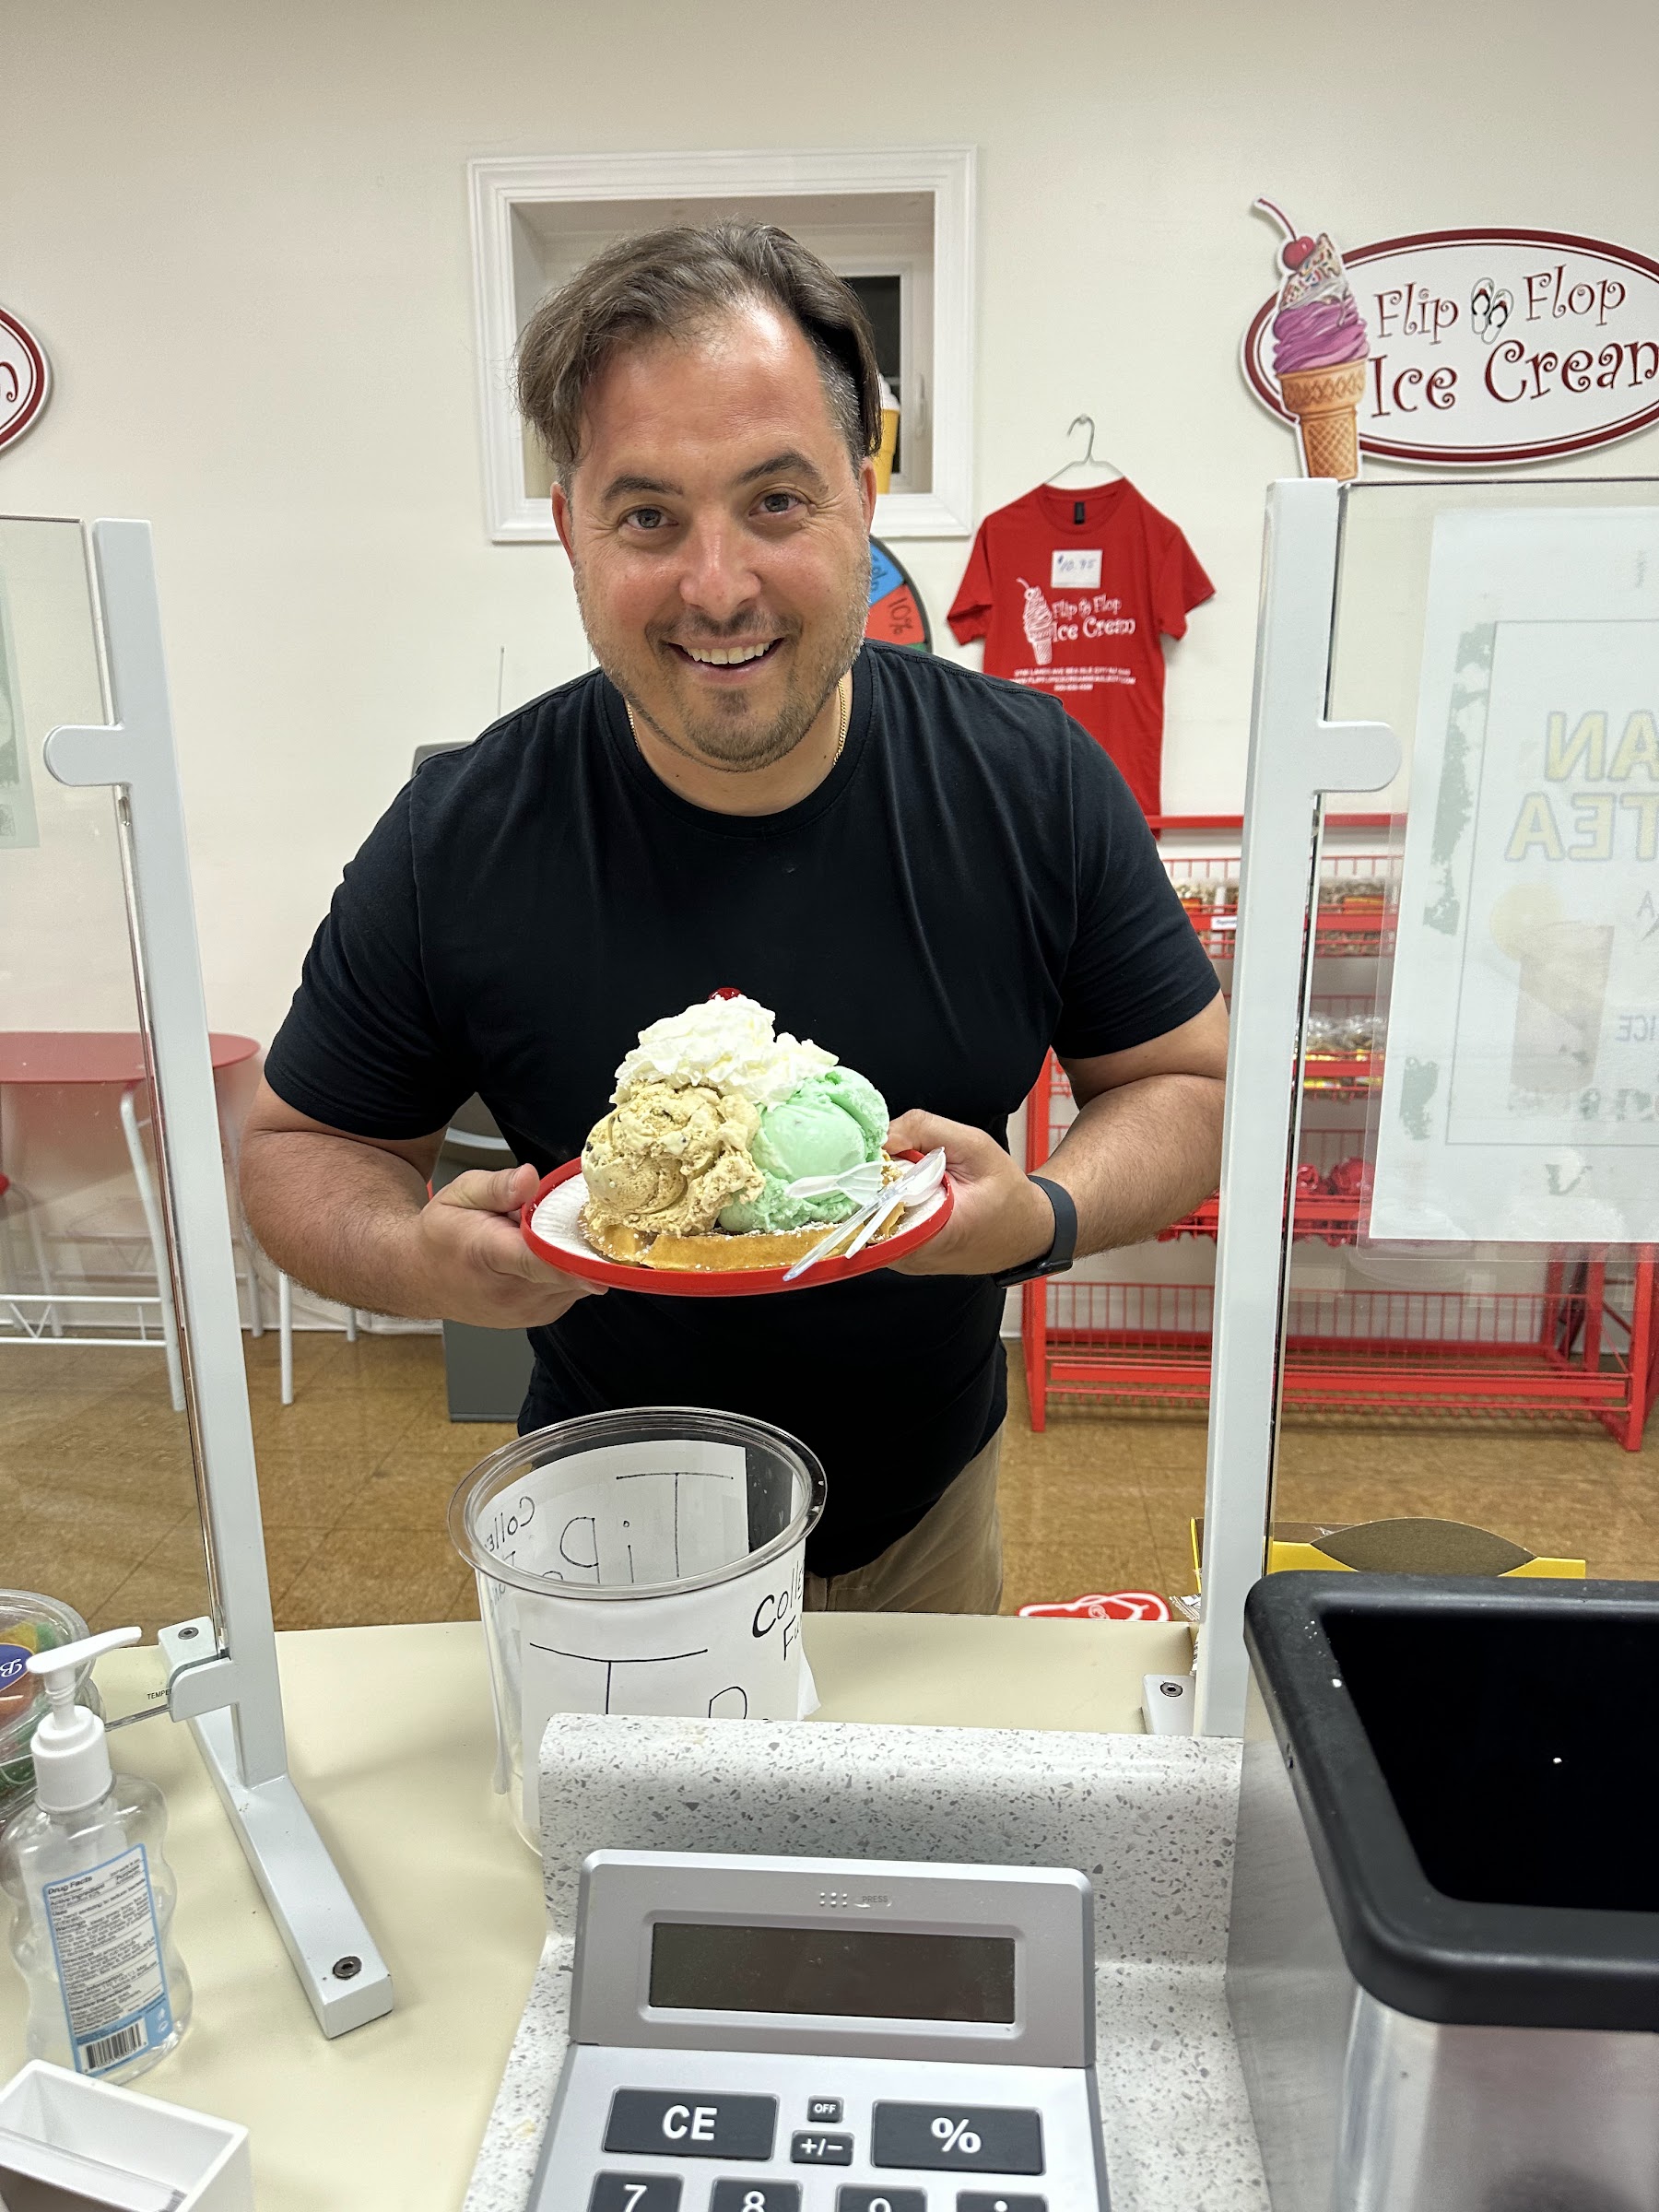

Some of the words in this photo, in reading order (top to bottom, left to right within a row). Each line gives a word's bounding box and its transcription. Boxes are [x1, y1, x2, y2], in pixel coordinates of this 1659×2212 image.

[1372, 281, 1459, 345] Flip
[1524, 264, 1626, 326] Flop
[1367, 355, 1458, 418] Ice
[1052, 598, 1077, 621] Flip
[1093, 593, 1122, 615] Flop
[1052, 620, 1078, 642] Ice
[1083, 615, 1136, 638] Cream
[48, 1884, 69, 1895] Drug
[69, 1876, 93, 1888] Facts
[862, 1895, 888, 1903] PRESS
[814, 2102, 837, 2114] OFF
[661, 2104, 718, 2141] CE
[931, 2117, 982, 2154] %
[622, 2183, 648, 2212] 7
[742, 2190, 766, 2212] 8
